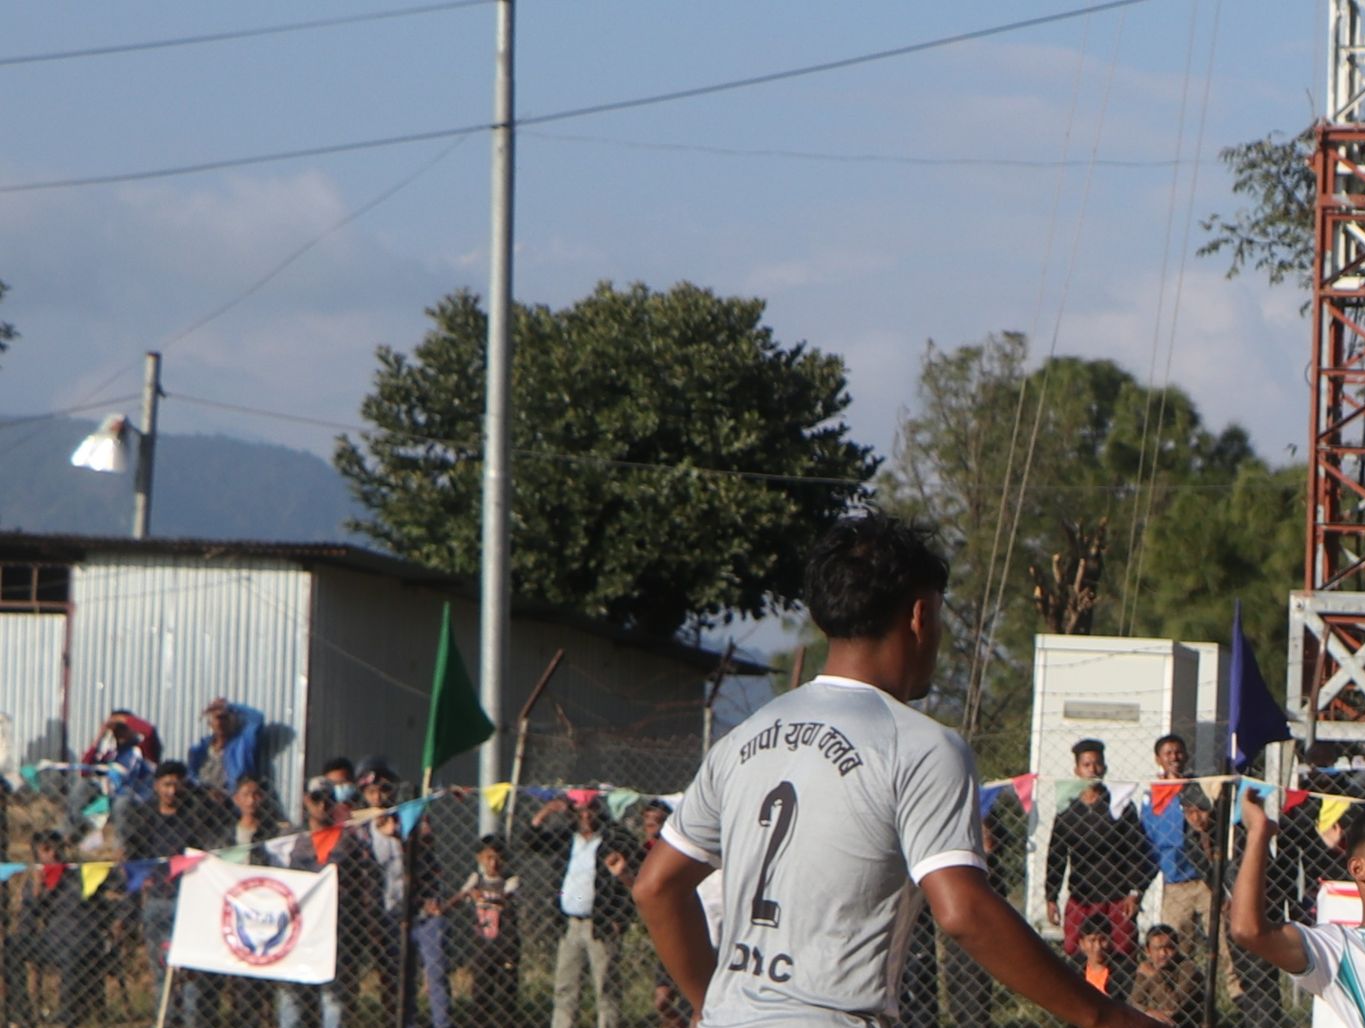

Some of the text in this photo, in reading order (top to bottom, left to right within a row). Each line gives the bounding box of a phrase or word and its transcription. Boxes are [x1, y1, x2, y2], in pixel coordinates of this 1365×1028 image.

[784, 721, 826, 752] युवा
[818, 725, 864, 777] क्लब
[751, 780, 798, 928] 2
